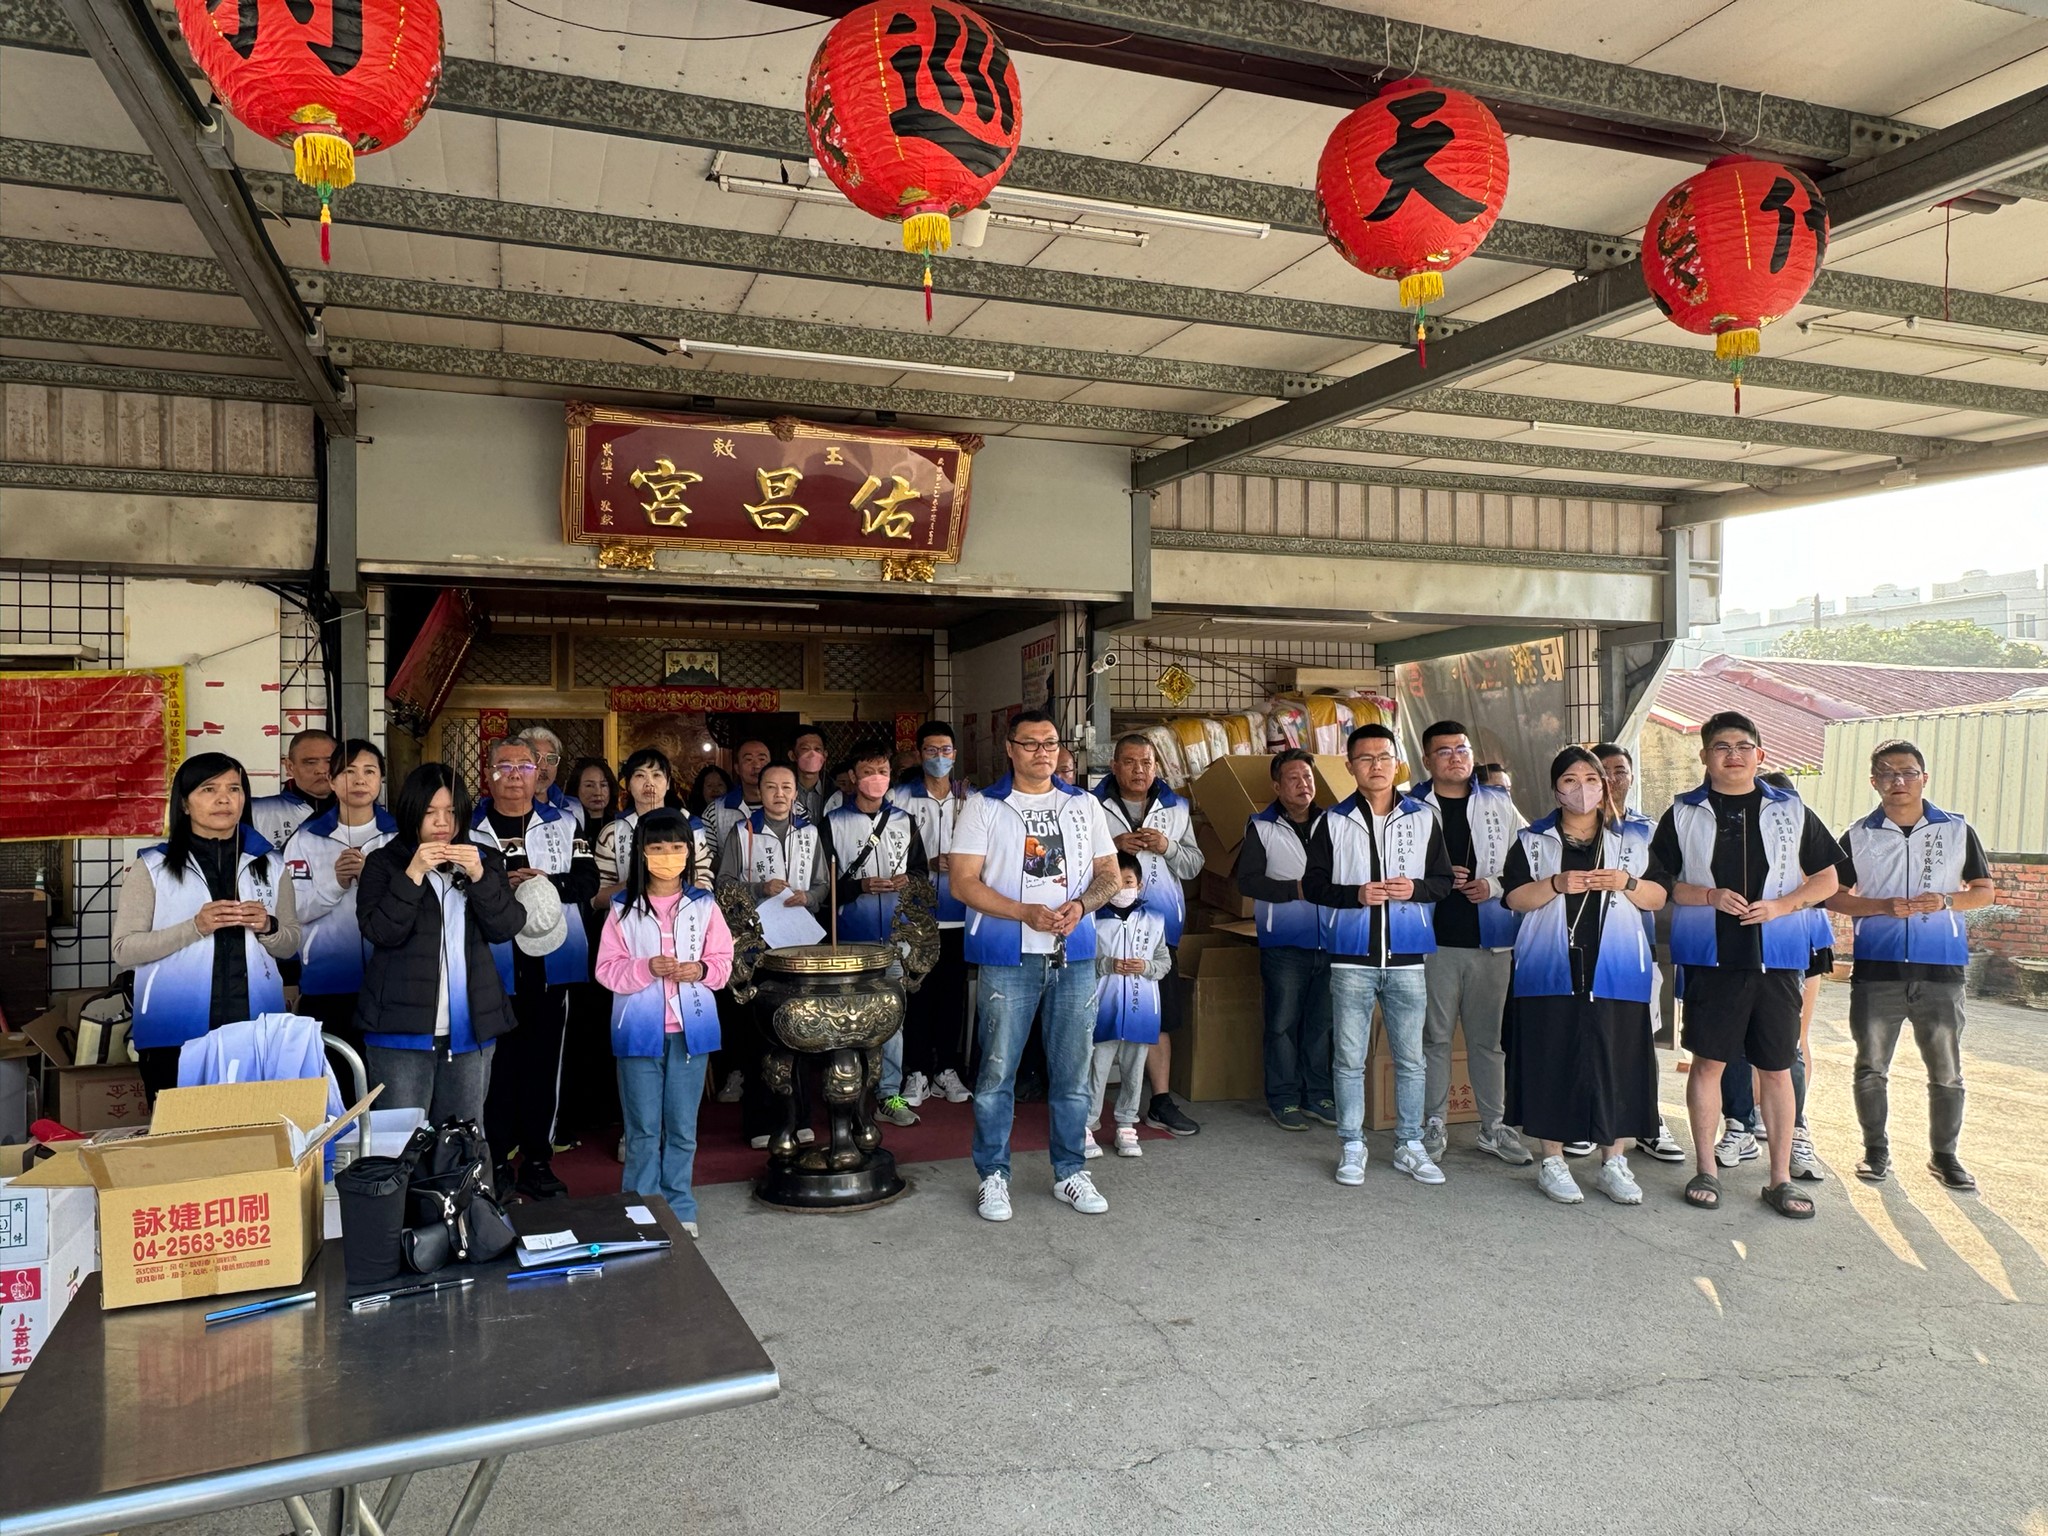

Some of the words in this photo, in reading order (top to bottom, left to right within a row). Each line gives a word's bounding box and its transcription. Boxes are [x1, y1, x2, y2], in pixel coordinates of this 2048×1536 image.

[1364, 91, 1488, 224] 天
[629, 458, 921, 539] 佑昌宮
[132, 1192, 270, 1239] 詠婕印刷
[133, 1224, 271, 1262] 04-2563-3652
